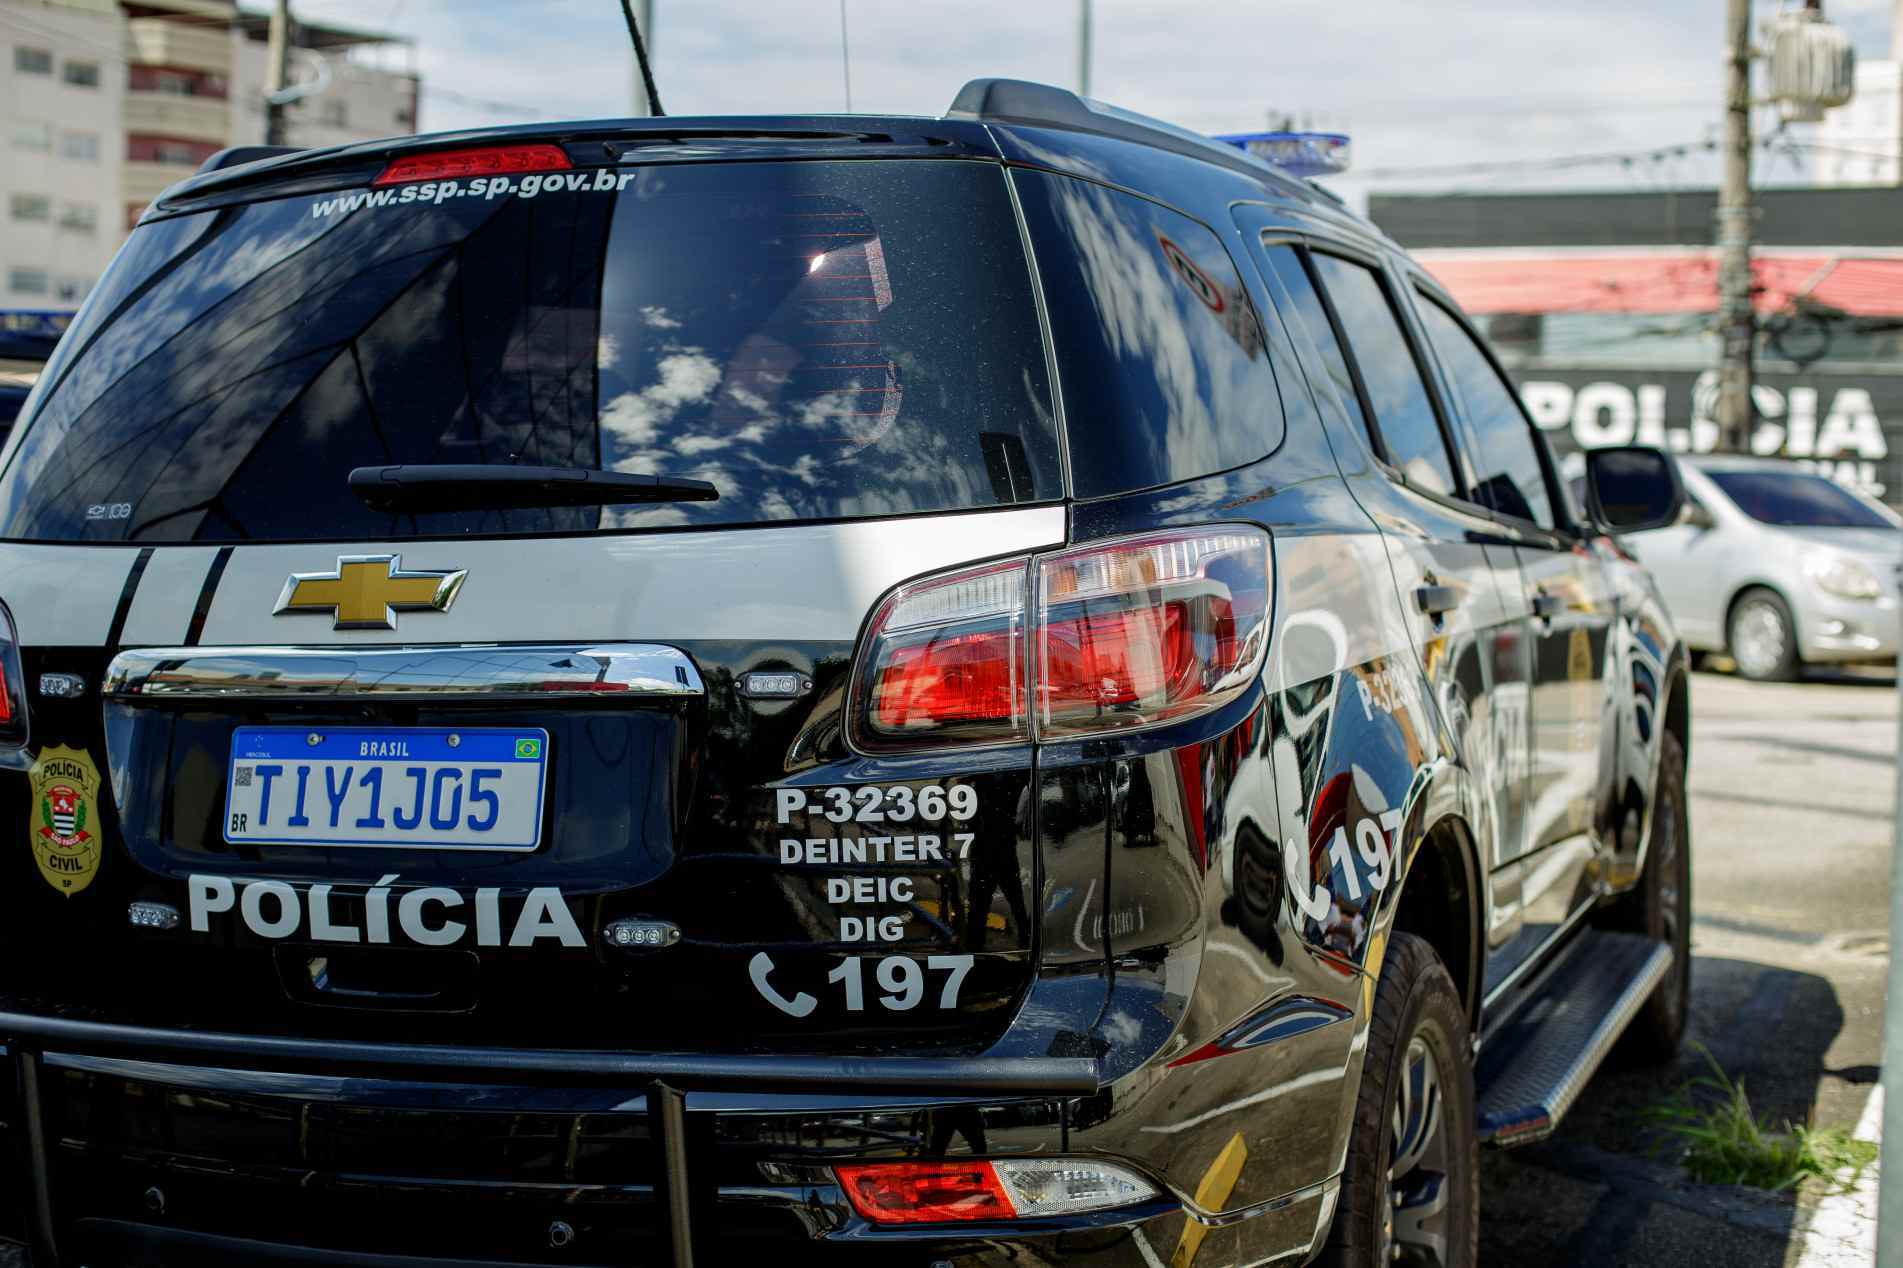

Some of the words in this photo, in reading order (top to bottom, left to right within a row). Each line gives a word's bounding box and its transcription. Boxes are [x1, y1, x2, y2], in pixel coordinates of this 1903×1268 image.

[312, 168, 635, 218] www.ssp.sp.gov.br
[360, 741, 409, 757] BRASIL
[43, 759, 83, 782] POLÍCIA
[255, 764, 502, 832] TIY1J05
[776, 785, 978, 824] P-32369
[231, 813, 247, 832] BR
[49, 855, 83, 872] CIVIL
[780, 834, 943, 864] DEINTER
[954, 833, 975, 859] 7
[1329, 807, 1403, 901] 197
[827, 877, 914, 904] DEIC
[188, 874, 587, 947] POLÍCIA
[840, 916, 904, 942] DIG
[828, 955, 975, 1011] 197
